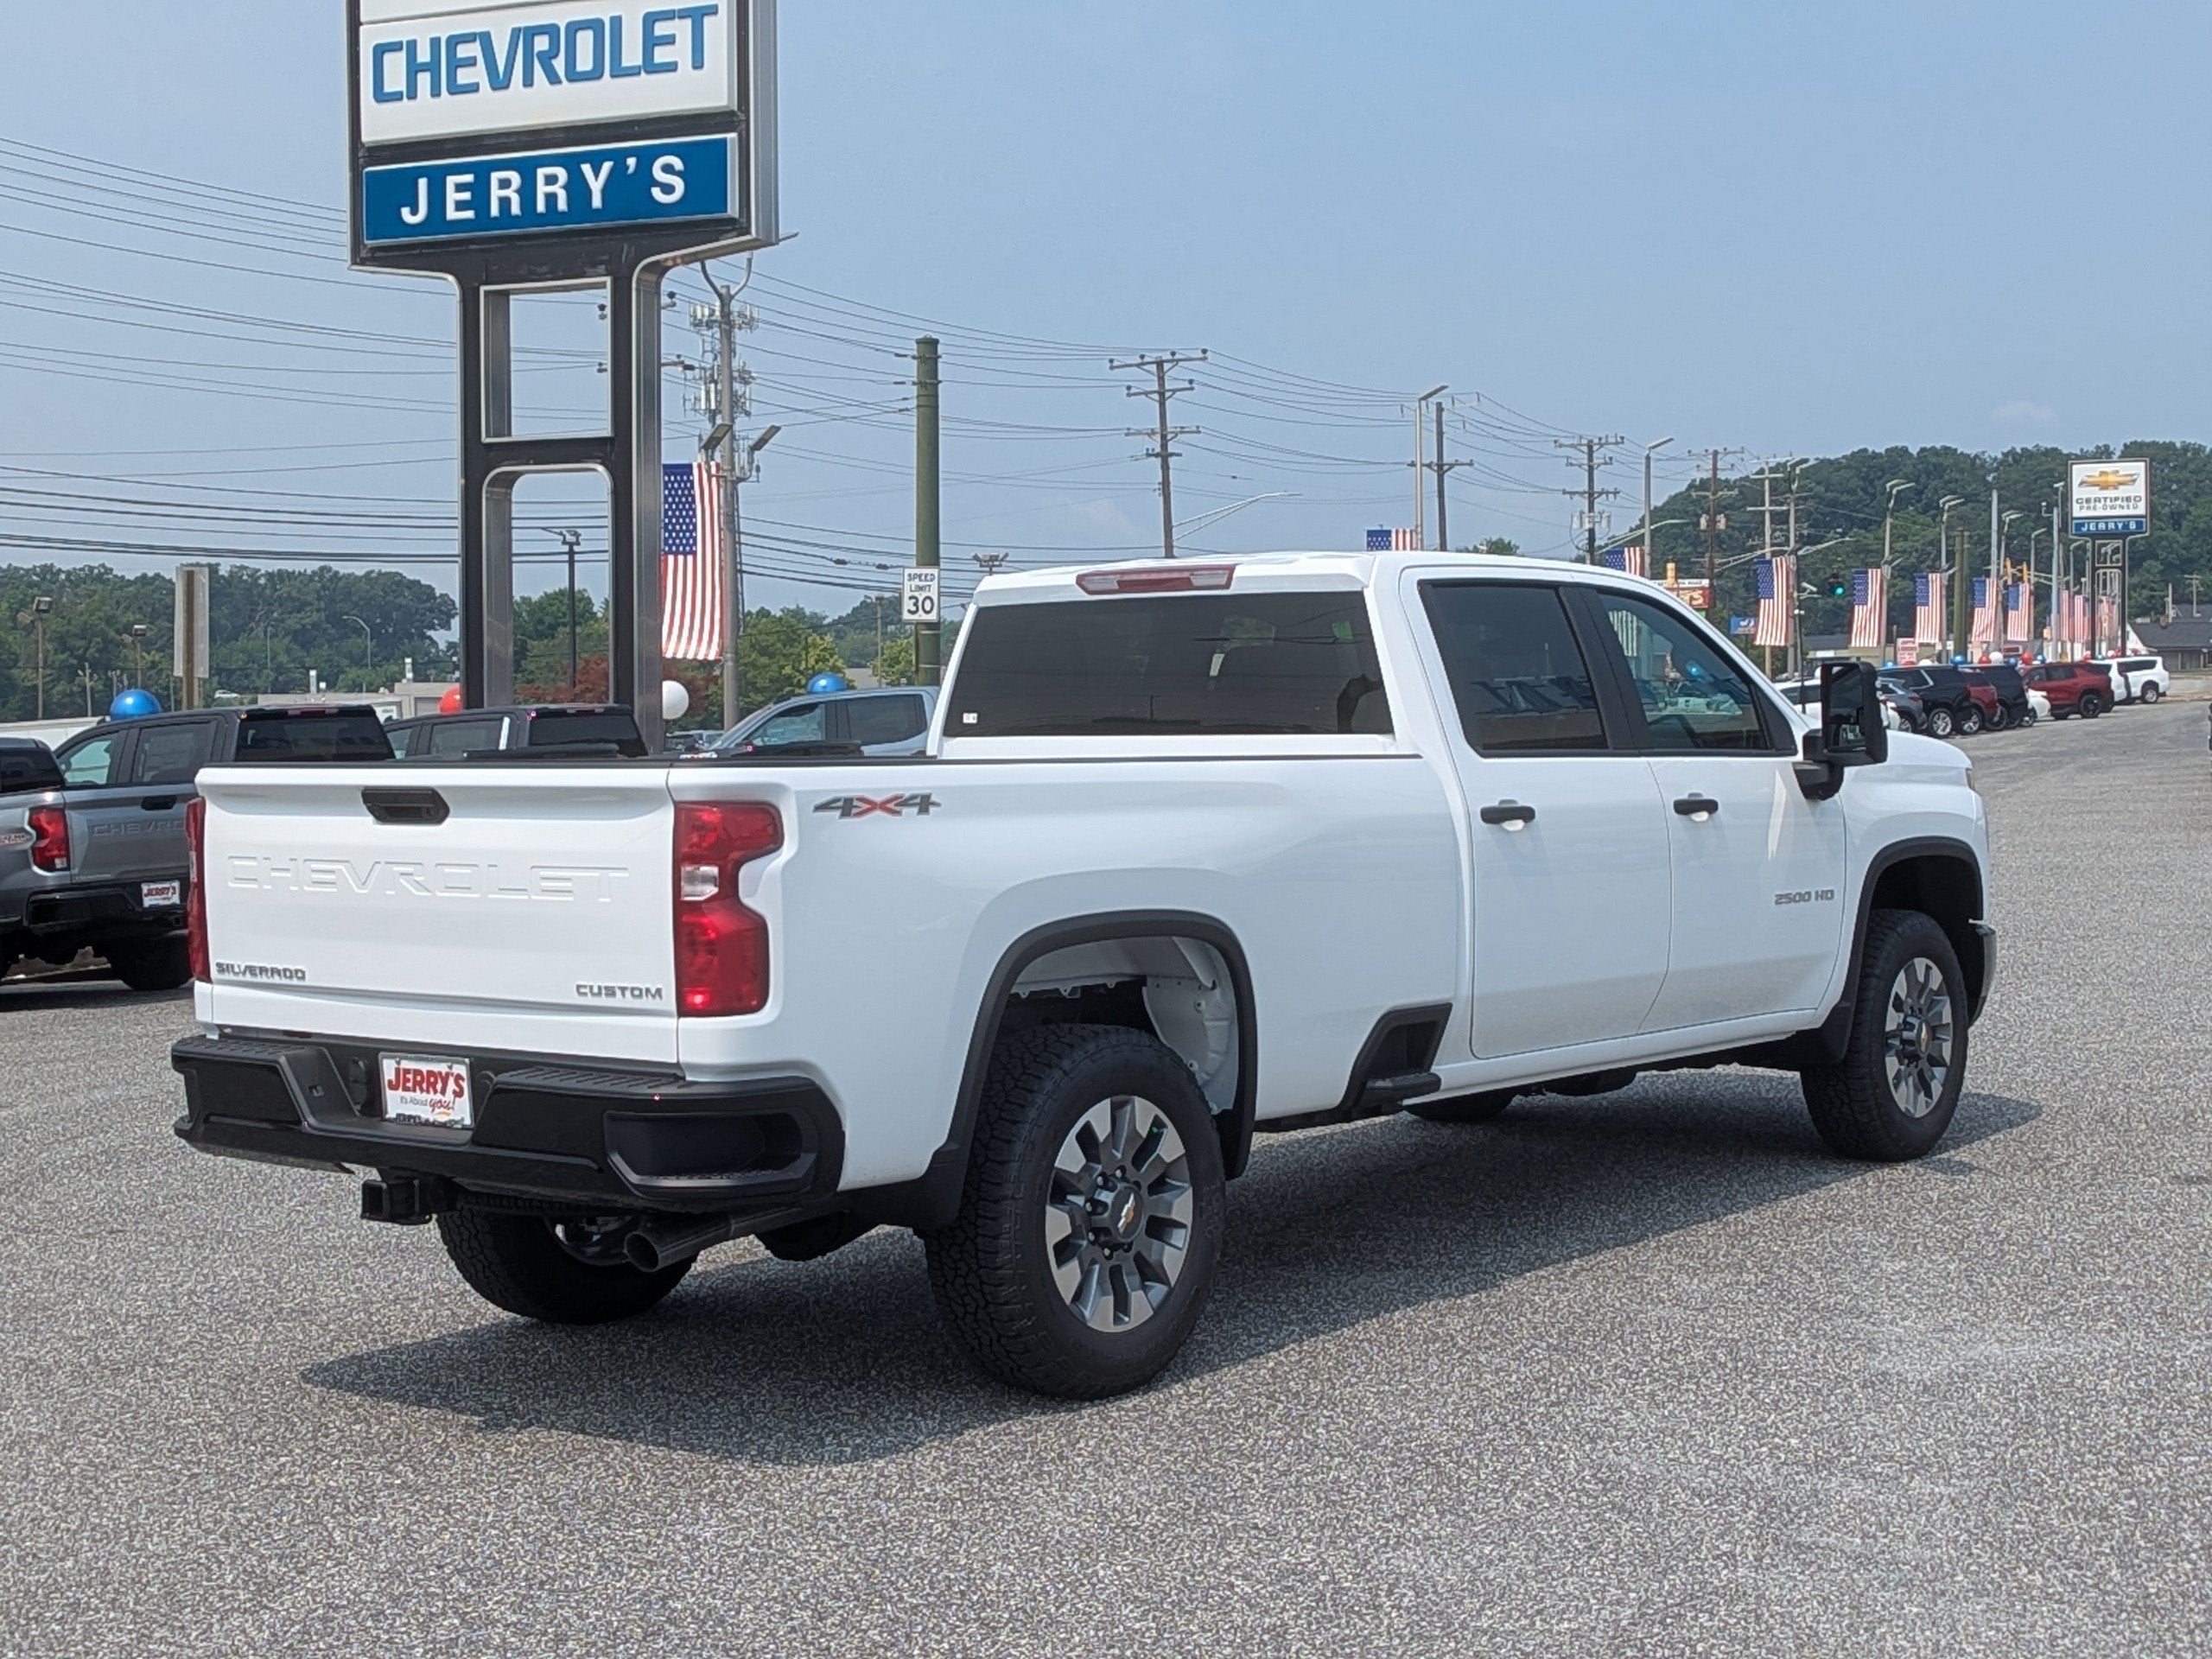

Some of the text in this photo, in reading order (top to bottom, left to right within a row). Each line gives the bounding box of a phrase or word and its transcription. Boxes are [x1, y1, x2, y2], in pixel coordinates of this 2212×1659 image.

[372, 3, 719, 103] CHEVROLET
[400, 155, 685, 225] JERRY'S
[2075, 495, 2142, 505] CERTIFIED
[2081, 521, 2136, 531] JERRY'S
[907, 573, 936, 582] SPEED
[907, 595, 934, 614] 30
[227, 855, 629, 901] CHEVROLET
[1775, 889, 1834, 906] 2500 HD
[215, 962, 306, 981] SILVERADO
[575, 984, 664, 1001] CUSTOM
[387, 1066, 466, 1099] JERRY'S
